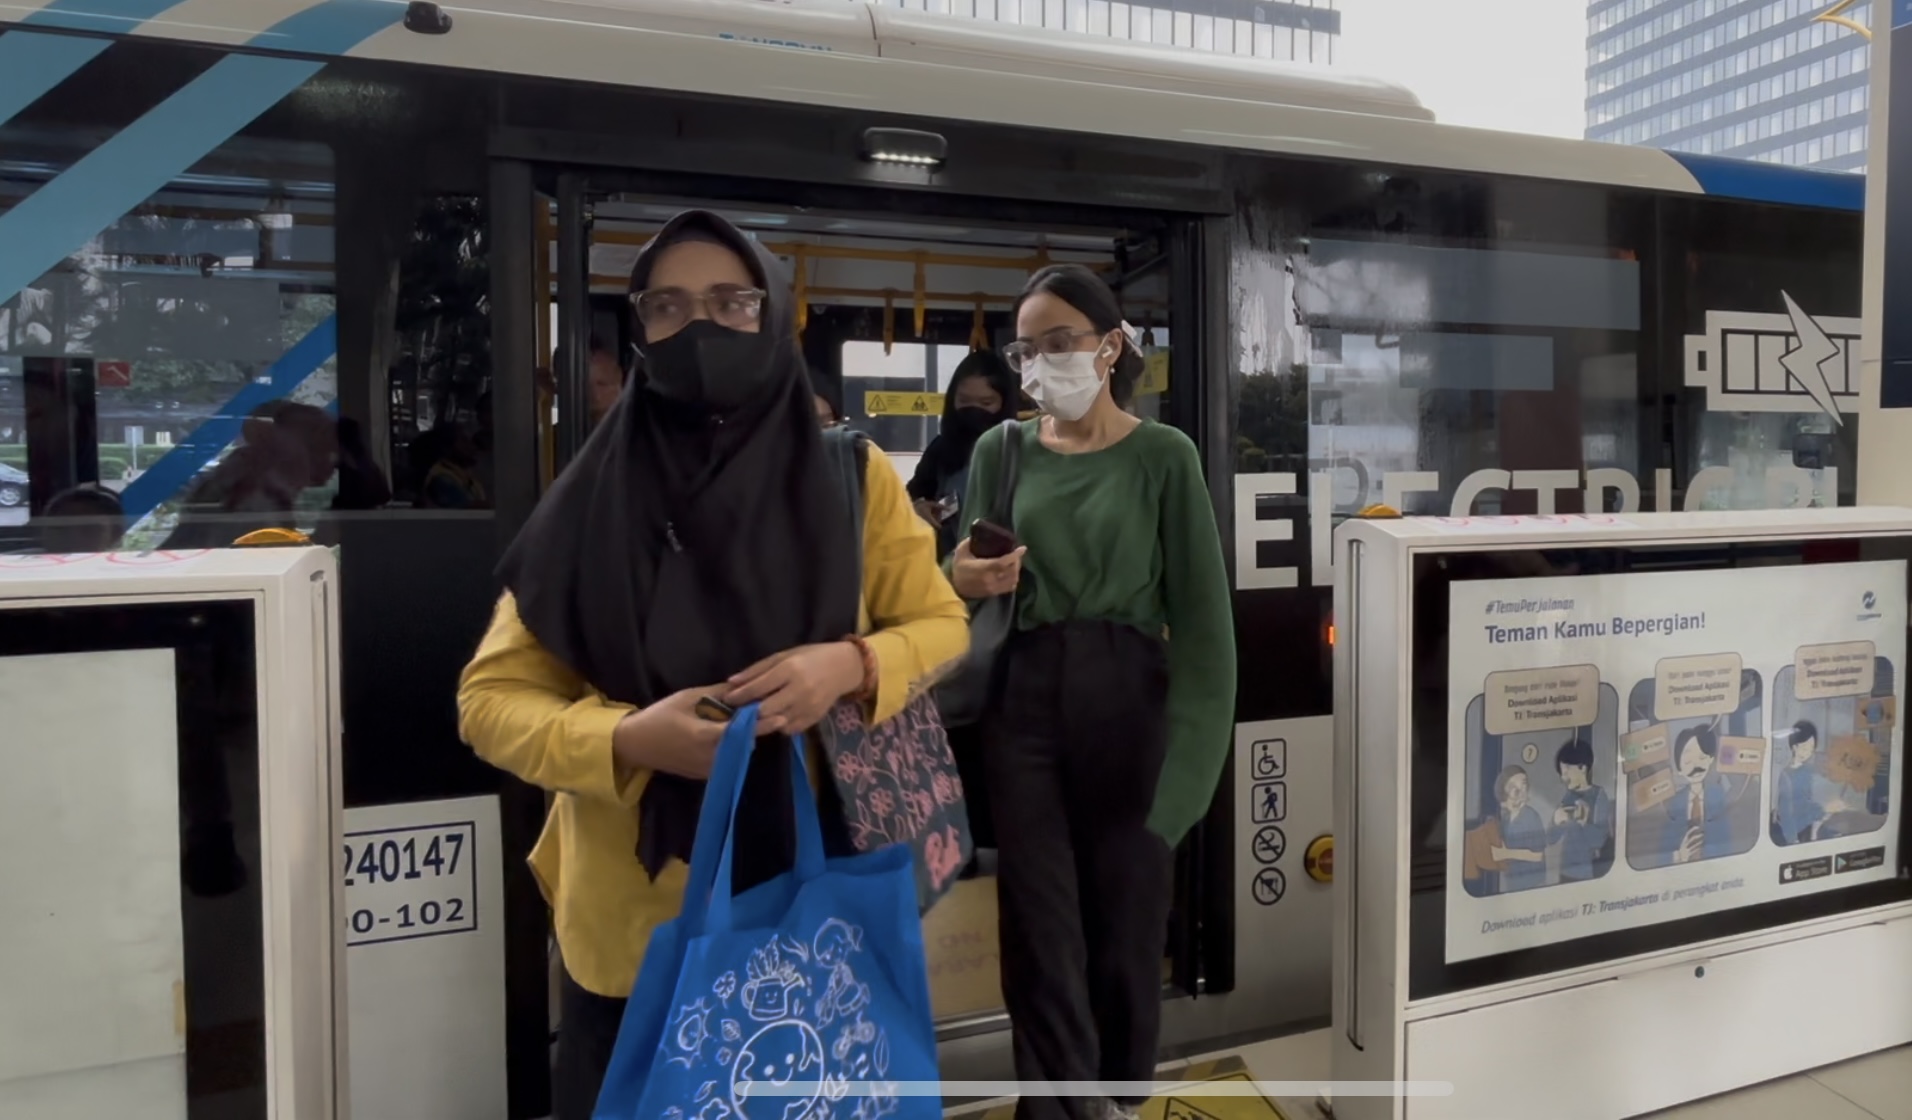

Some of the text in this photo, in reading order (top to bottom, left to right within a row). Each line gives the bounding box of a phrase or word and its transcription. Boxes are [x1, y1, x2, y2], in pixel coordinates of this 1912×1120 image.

[1485, 612, 1706, 644] Teman Kamu Bepergian!
[345, 897, 465, 934] 0-102
[1481, 912, 1537, 935] Download
[1539, 906, 1580, 926] aplikasi
[1599, 893, 1660, 913] Transjakarta
